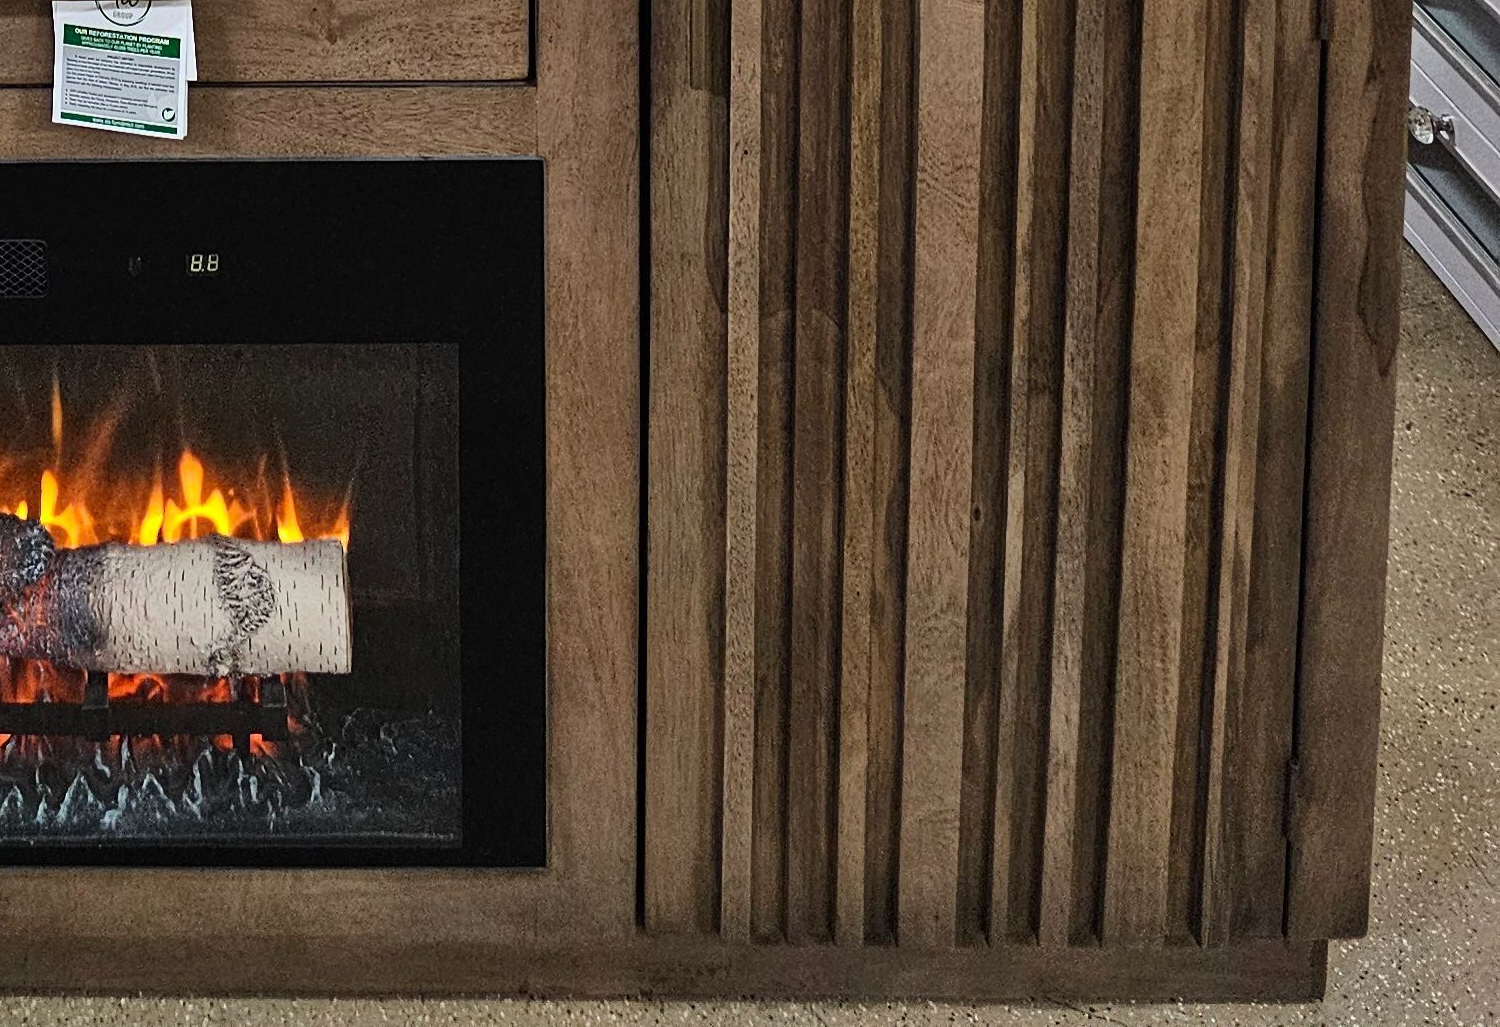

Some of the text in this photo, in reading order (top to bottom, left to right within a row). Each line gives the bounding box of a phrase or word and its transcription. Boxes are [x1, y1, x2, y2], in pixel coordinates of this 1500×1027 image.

[112, 10, 133, 19] GROUP
[74, 27, 170, 45] OUR REFORESTATION PROGRAM
